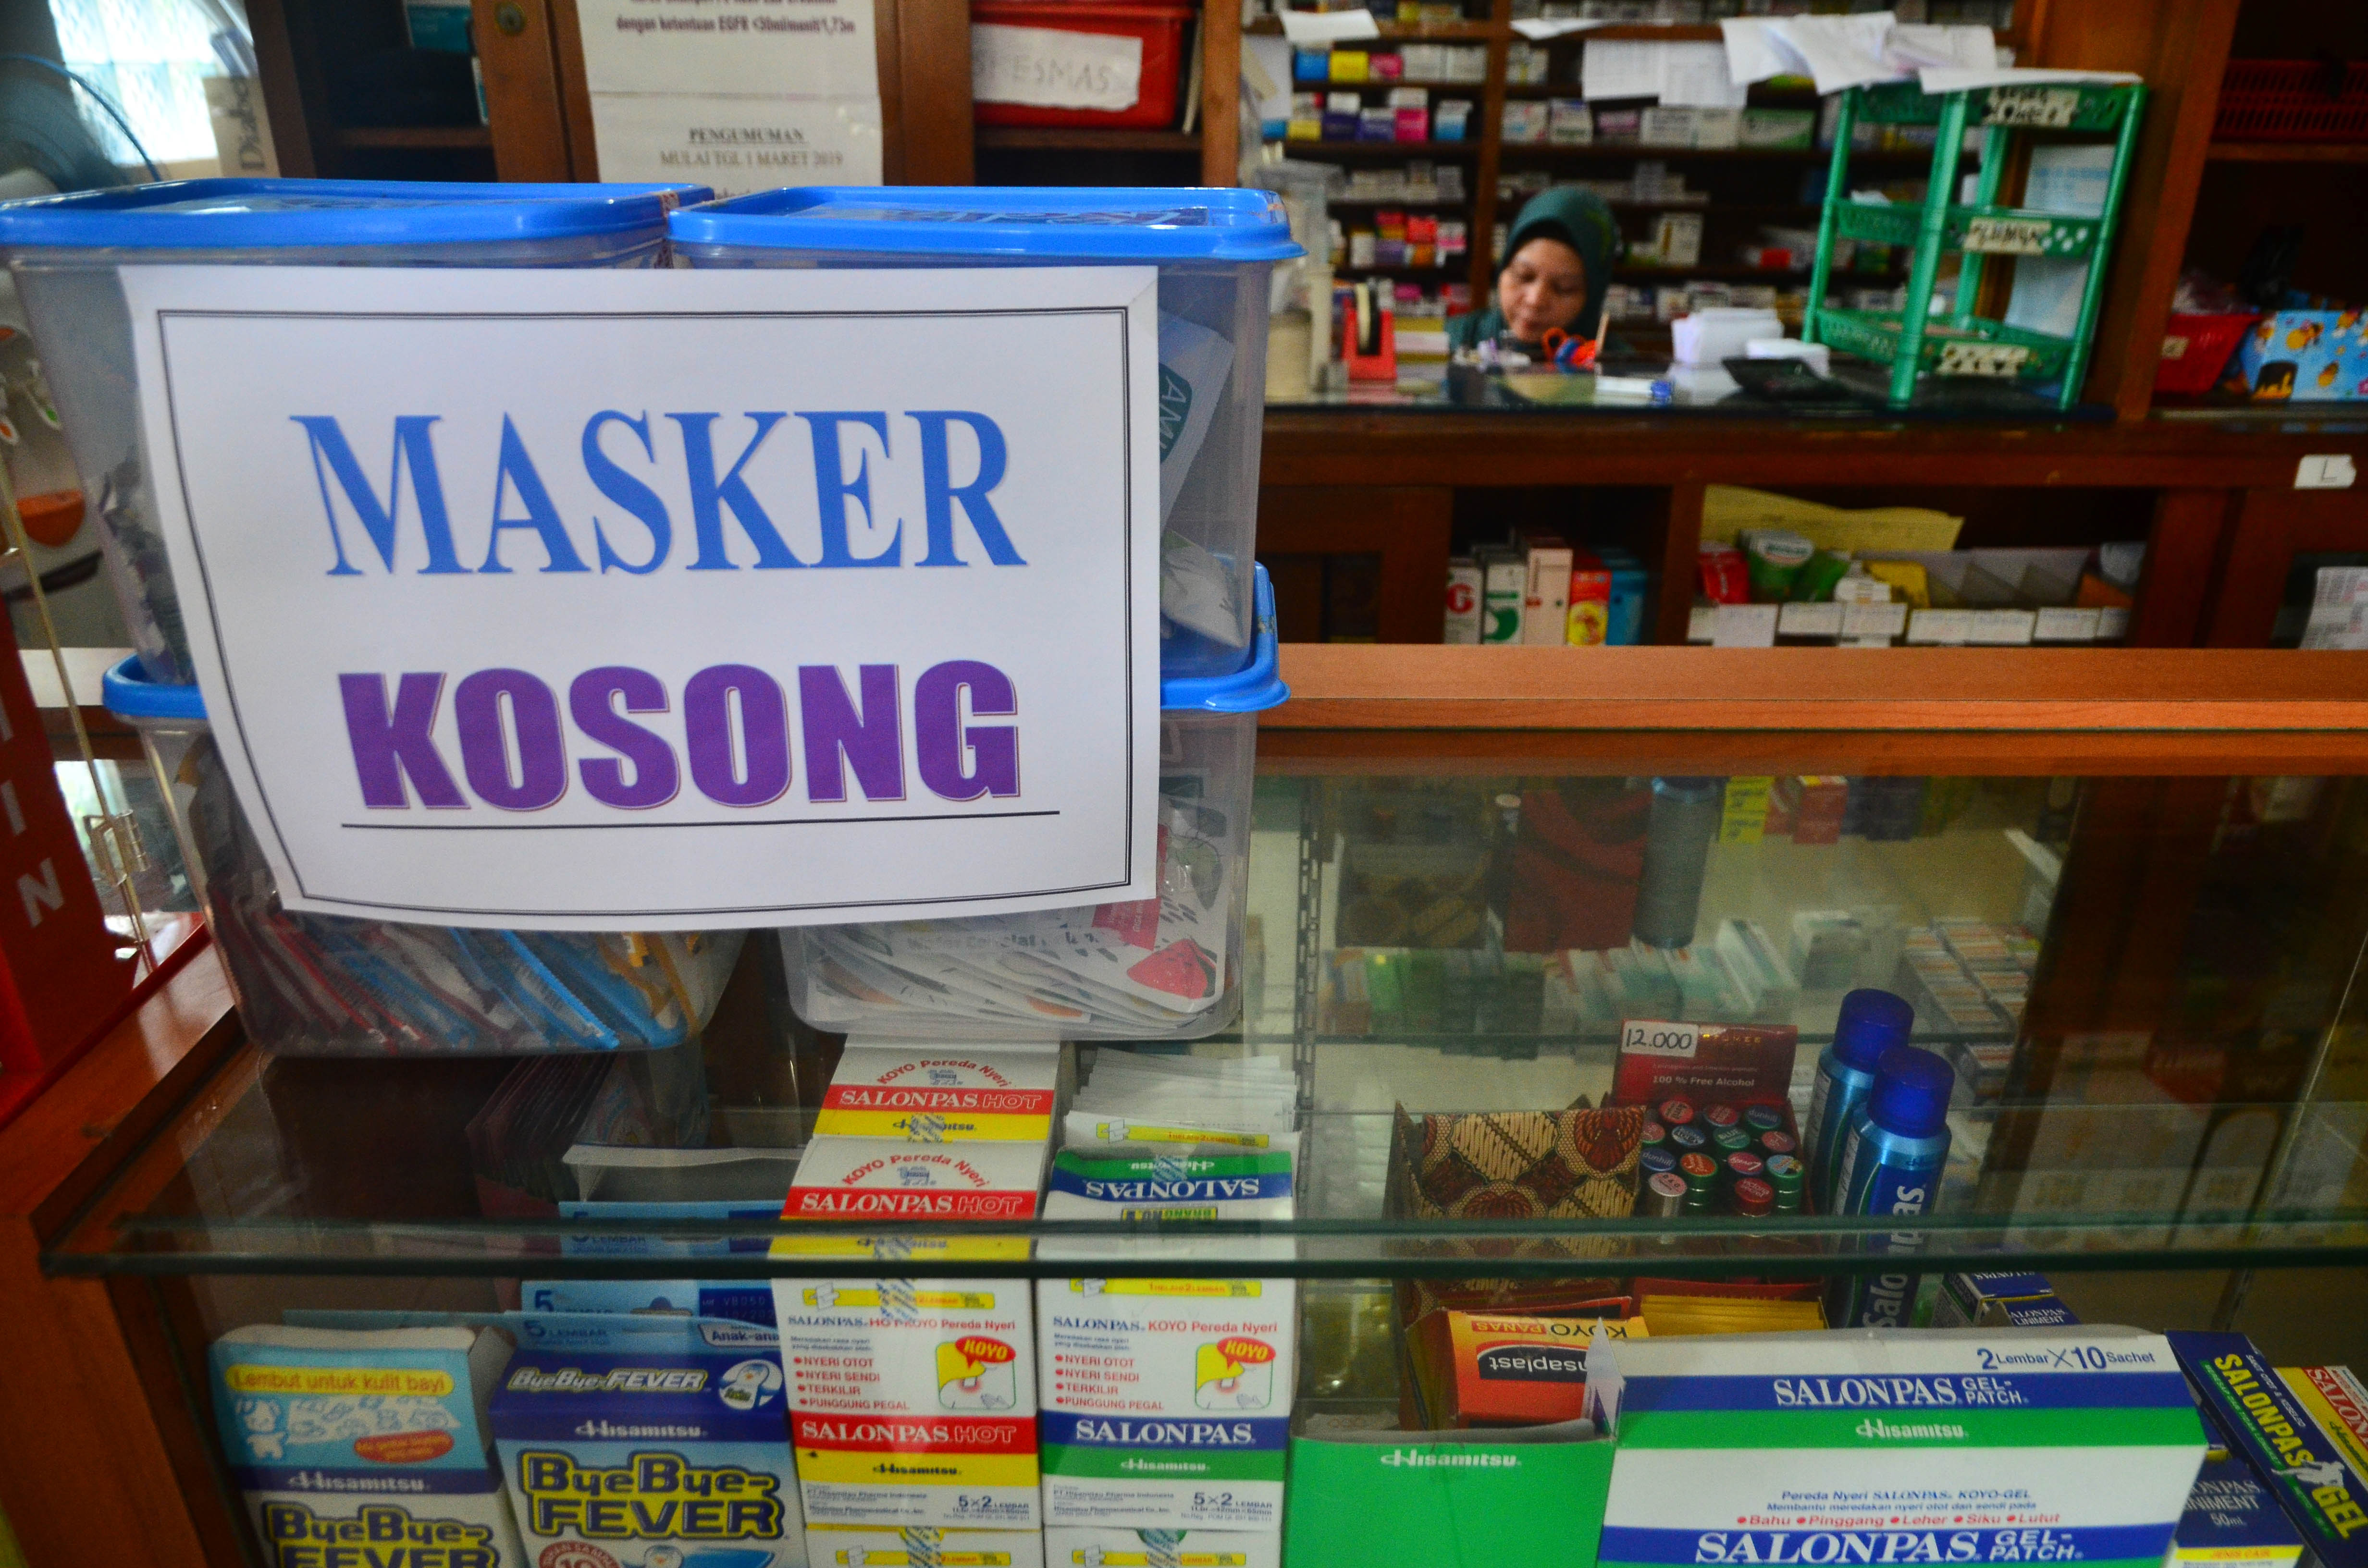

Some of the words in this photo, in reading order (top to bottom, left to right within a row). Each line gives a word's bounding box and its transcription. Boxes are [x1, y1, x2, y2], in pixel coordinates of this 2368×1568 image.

[689, 127, 807, 144] PENGUMUMAN
[660, 150, 703, 166] MULAI
[706, 151, 739, 166] TGL
[756, 151, 808, 167] MARET
[288, 408, 1027, 576] MASKER
[337, 660, 1022, 811] KOSONG
[1626, 1029, 1692, 1049] 12.000
[876, 1063, 915, 1085] KOYO
[920, 1059, 978, 1069] Pereda
[979, 1065, 1011, 1088] Nyeri
[1653, 1076, 1672, 1084] 100
[1676, 1077, 1687, 1085] %
[1690, 1077, 1713, 1085] Free
[1715, 1078, 1755, 1087] Alcohol
[839, 1090, 978, 1109] SALONPAS
[982, 1094, 1042, 1110] HOT
[1748, 1108, 1777, 1123] dunhill
[1642, 1152, 1673, 1166] dunhill
[841, 1159, 884, 1186] KOYO
[889, 1154, 952, 1165] Pereda
[954, 1161, 990, 1188] Nyeri
[1085, 1178, 1261, 1202] SALONPAS
[800, 1192, 953, 1213] SALONPAS
[957, 1196, 1024, 1216] HOT
[534, 1289, 554, 1312] 5
[2010, 1308, 2068, 1319] ALONPAS
[2014, 1316, 2065, 1326] LINIMENT
[524, 1320, 546, 1337] 5
[788, 1315, 865, 1327] SALONPAS
[940, 1319, 981, 1329] Pereda
[985, 1320, 1016, 1332] Nyeri
[1053, 1316, 1141, 1332] SALONPAS
[1147, 1320, 1187, 1332] KOYO
[1191, 1321, 1238, 1333] Pereda
[1242, 1323, 1278, 1335] Nyeri
[1473, 1322, 1546, 1334] PANAS
[711, 1330, 780, 1341] Anak-ana
[963, 1339, 1009, 1360] KOYO
[1224, 1339, 1268, 1360] KOYO
[2072, 1346, 2107, 1371] 10
[2107, 1350, 2157, 1365] Sachet
[804, 1357, 840, 1366] NYERI
[842, 1358, 874, 1367] OTOT
[1065, 1355, 1100, 1366] NYERI
[1104, 1358, 1135, 1367] OTOT
[1489, 1355, 1588, 1374] nsaplast
[234, 1370, 301, 1390] Lembut
[307, 1374, 358, 1390] untuk
[362, 1374, 400, 1391] kulit
[406, 1374, 445, 1394] bayi
[513, 1369, 706, 1390] ByeBye-FEVER
[805, 1371, 842, 1380] NYERI
[844, 1372, 880, 1382] SENDI
[1066, 1369, 1100, 1380] NYERI
[1104, 1371, 1139, 1383] SENDI
[807, 1385, 861, 1395] TERKILIR
[1066, 1383, 1119, 1395] TERKILIR
[1774, 1378, 1960, 1407] SALONPAS
[1962, 1377, 2013, 1391] GEL-
[1965, 1390, 2022, 1405] PATCH
[809, 1398, 870, 1409] PUNGGUNG
[873, 1400, 910, 1410] PEGAL
[1065, 1396, 1126, 1409] PUNGGUNG
[1129, 1400, 1164, 1410] PEGAL
[575, 1420, 703, 1438] Hisamitsu
[802, 1421, 950, 1443] SALONPAS
[955, 1425, 1017, 1444] HOT
[1076, 1419, 1253, 1444] SALONPAS
[1856, 1418, 1965, 1440] Hisamitsu
[2214, 1354, 2315, 1468] SALONPAS
[2311, 1486, 2368, 1540] GEL
[1121, 1458, 1208, 1471] Hisamitsu
[1380, 1449, 1517, 1467] Hisamitsu
[528, 1450, 777, 1497] ByeBye-
[872, 1463, 958, 1475] Hisamitsu
[288, 1471, 425, 1492] Hisamitsu
[1781, 1490, 1828, 1501] Pereda
[1832, 1490, 1868, 1502] Nyeri
[1873, 1490, 1949, 1500] SALONPAS
[1958, 1490, 2031, 1500] KOYO-GEL
[2185, 1494, 2259, 1510] INIMENT
[1766, 1502, 1826, 1511] Membantu
[1829, 1503, 1891, 1511] meredakan
[1893, 1503, 1924, 1512] nyeri
[1925, 1502, 1949, 1511] otot
[1951, 1502, 1973, 1511] dan
[1975, 1502, 2007, 1511] sendi
[2008, 1502, 2037, 1513] pada
[269, 1505, 491, 1545] ByeBye-
[539, 1498, 778, 1537] FEVER
[1749, 1514, 1791, 1526] Bahu
[1808, 1515, 1885, 1529] Pinggang
[1902, 1514, 1948, 1525] Leher
[1966, 1514, 2001, 1525] Siku
[2018, 1513, 2060, 1524] Lutut
[1694, 1531, 1980, 1565] SALONPAS
[1993, 1529, 2073, 1547] GEL-
[1989, 1545, 2077, 1562] PATCH
